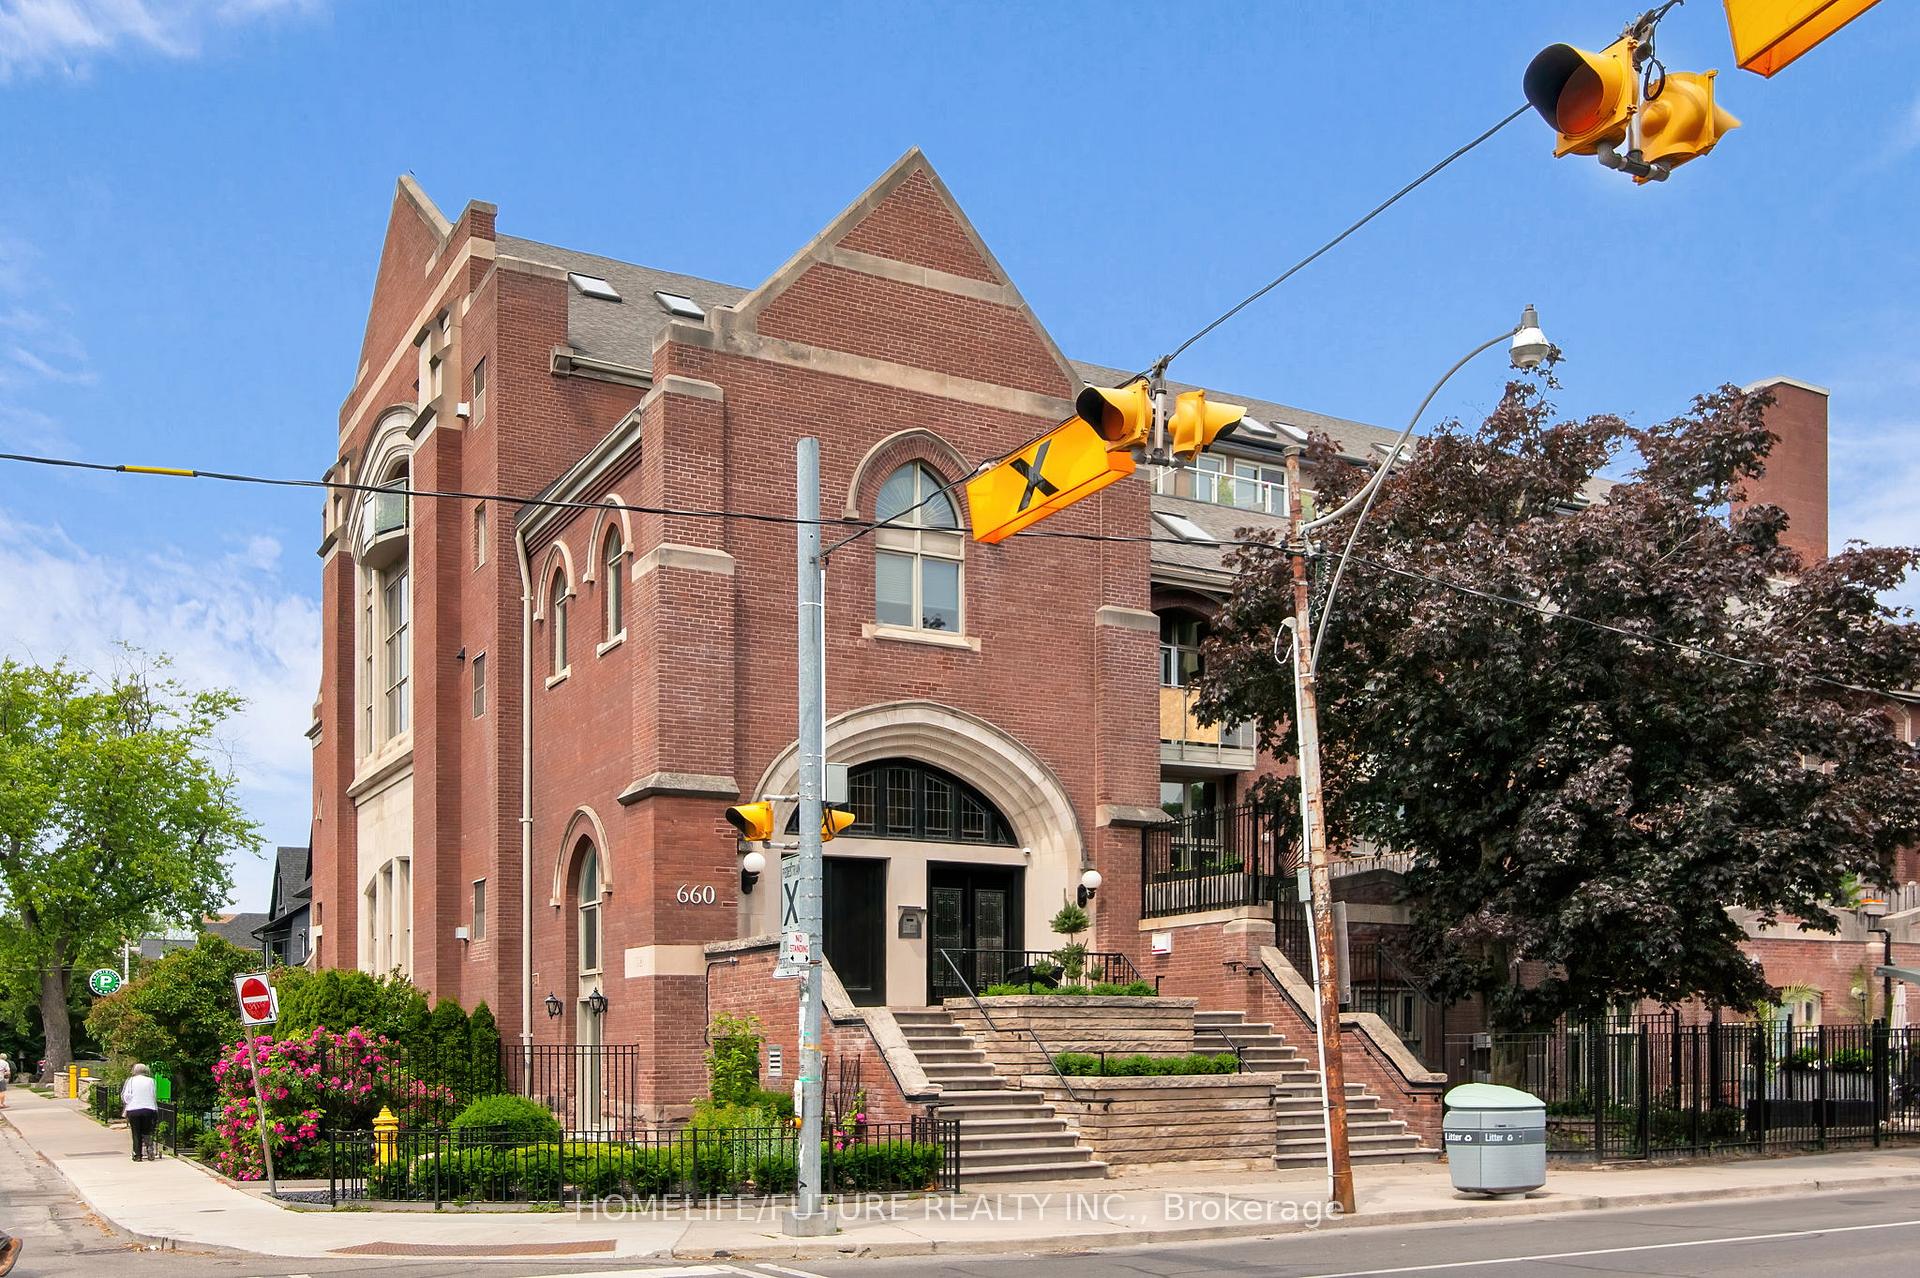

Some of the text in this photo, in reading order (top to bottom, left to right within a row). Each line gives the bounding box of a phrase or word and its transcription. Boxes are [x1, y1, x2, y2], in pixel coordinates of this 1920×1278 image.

[677, 884, 715, 904] 660
[784, 880, 798, 926] X
[795, 934, 803, 943] NO
[789, 944, 809, 953] STANDING
[1445, 1133, 1462, 1141] Litter
[1485, 1133, 1504, 1142] Litter
